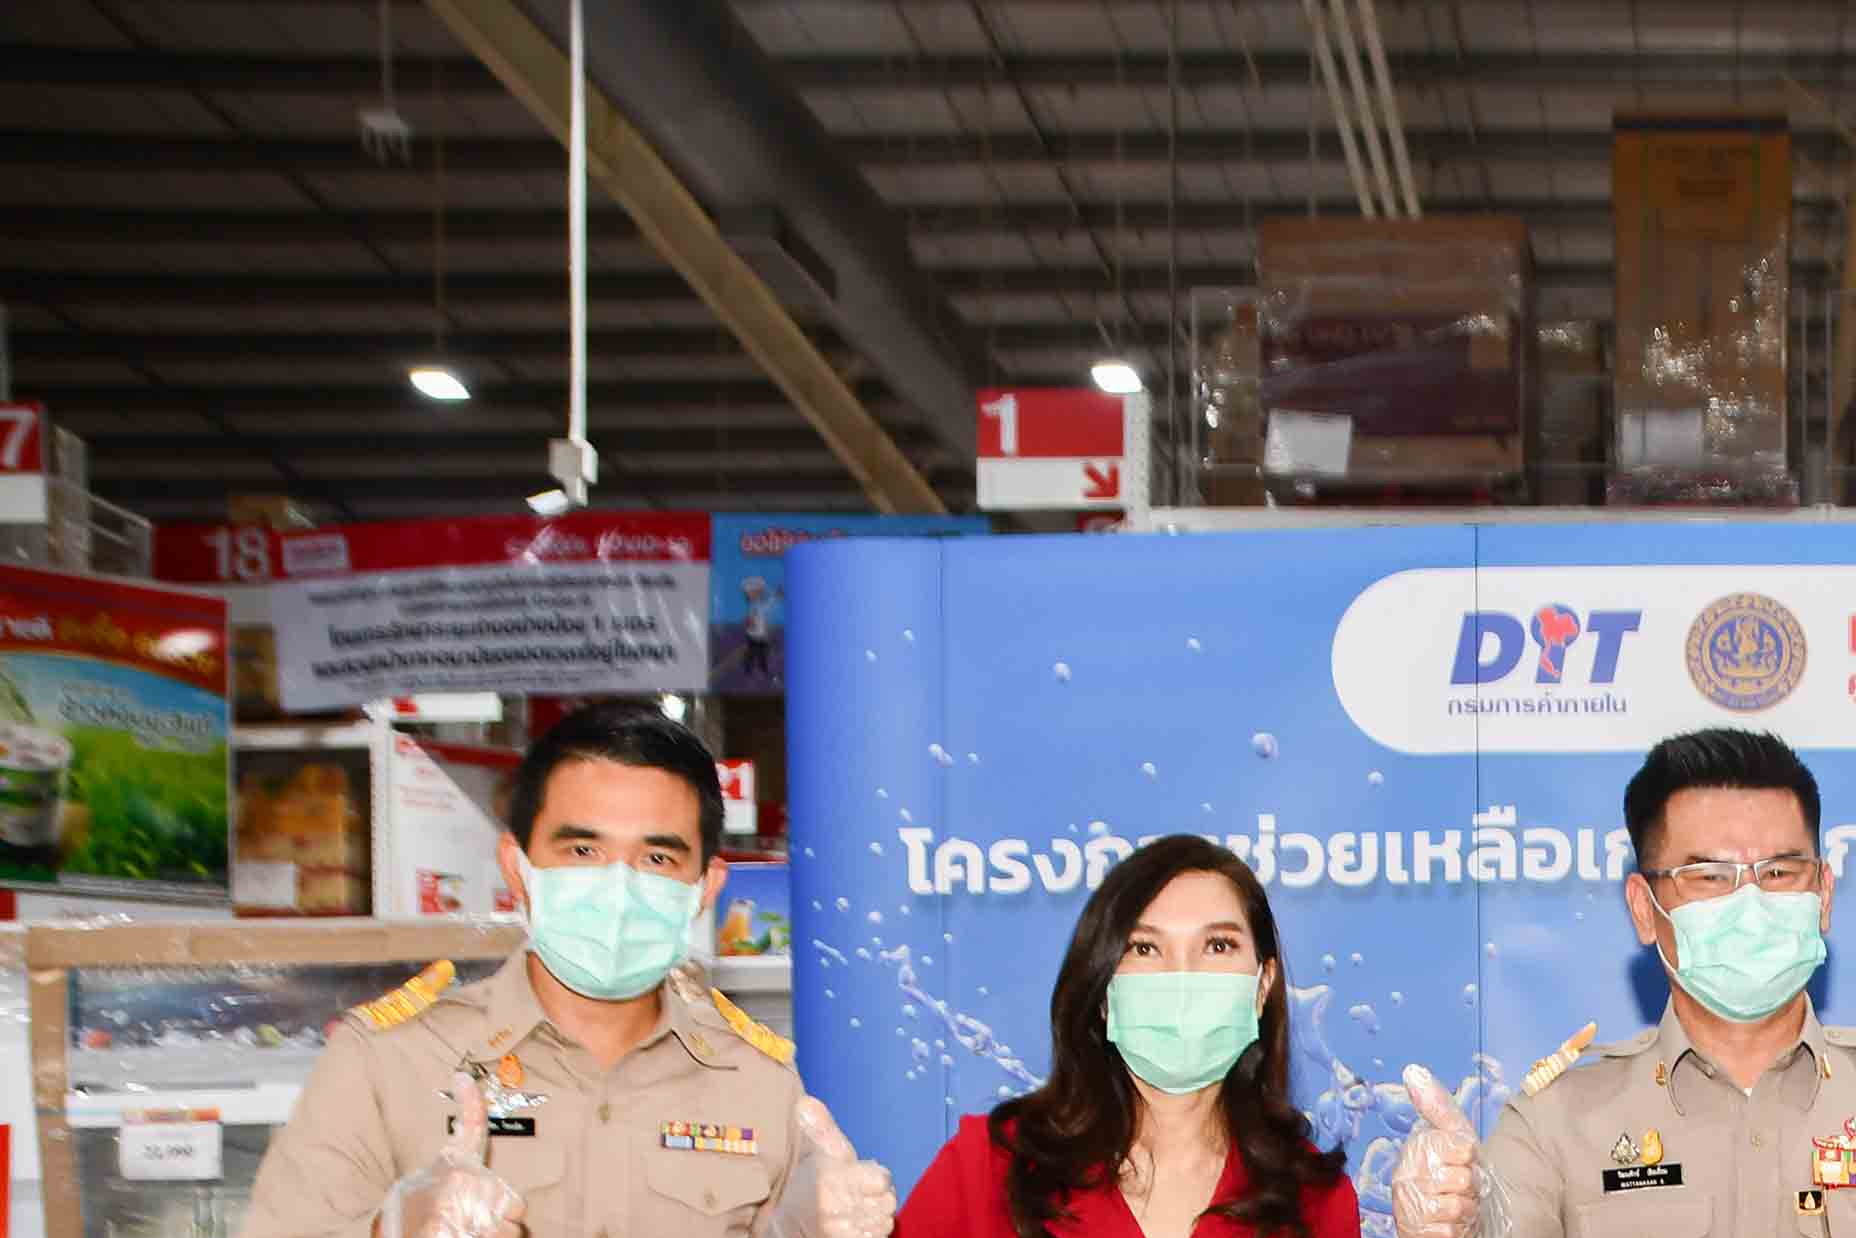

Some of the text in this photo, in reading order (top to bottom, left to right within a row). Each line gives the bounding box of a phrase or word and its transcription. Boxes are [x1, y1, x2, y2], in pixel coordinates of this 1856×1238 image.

[204, 525, 271, 578] 18
[1447, 689, 1627, 716] กรมการค้าภายใน
